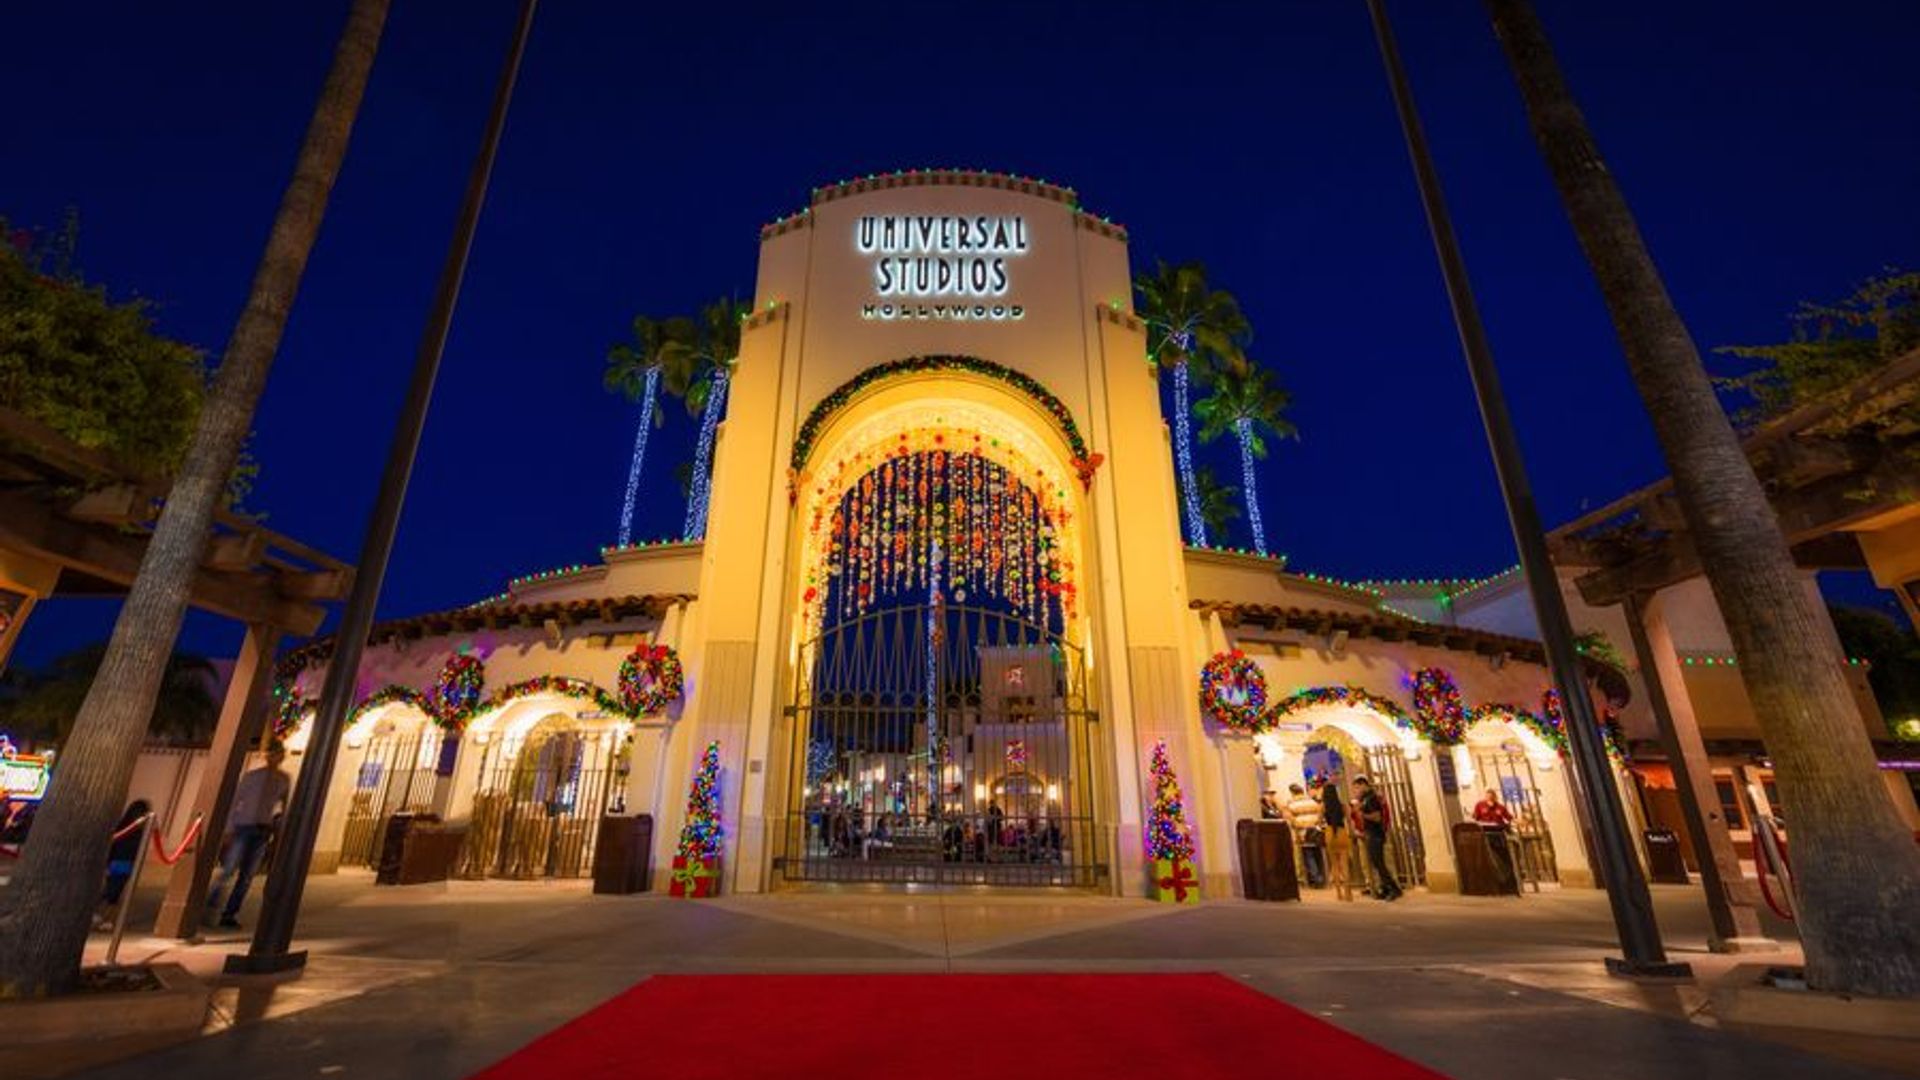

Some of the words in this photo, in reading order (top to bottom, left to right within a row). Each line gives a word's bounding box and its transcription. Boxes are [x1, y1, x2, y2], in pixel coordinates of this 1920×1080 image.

[861, 216, 1026, 250] UNIVERSAL
[879, 257, 1007, 292] STUDIOS
[862, 304, 1024, 317] HOLLYWOOD
